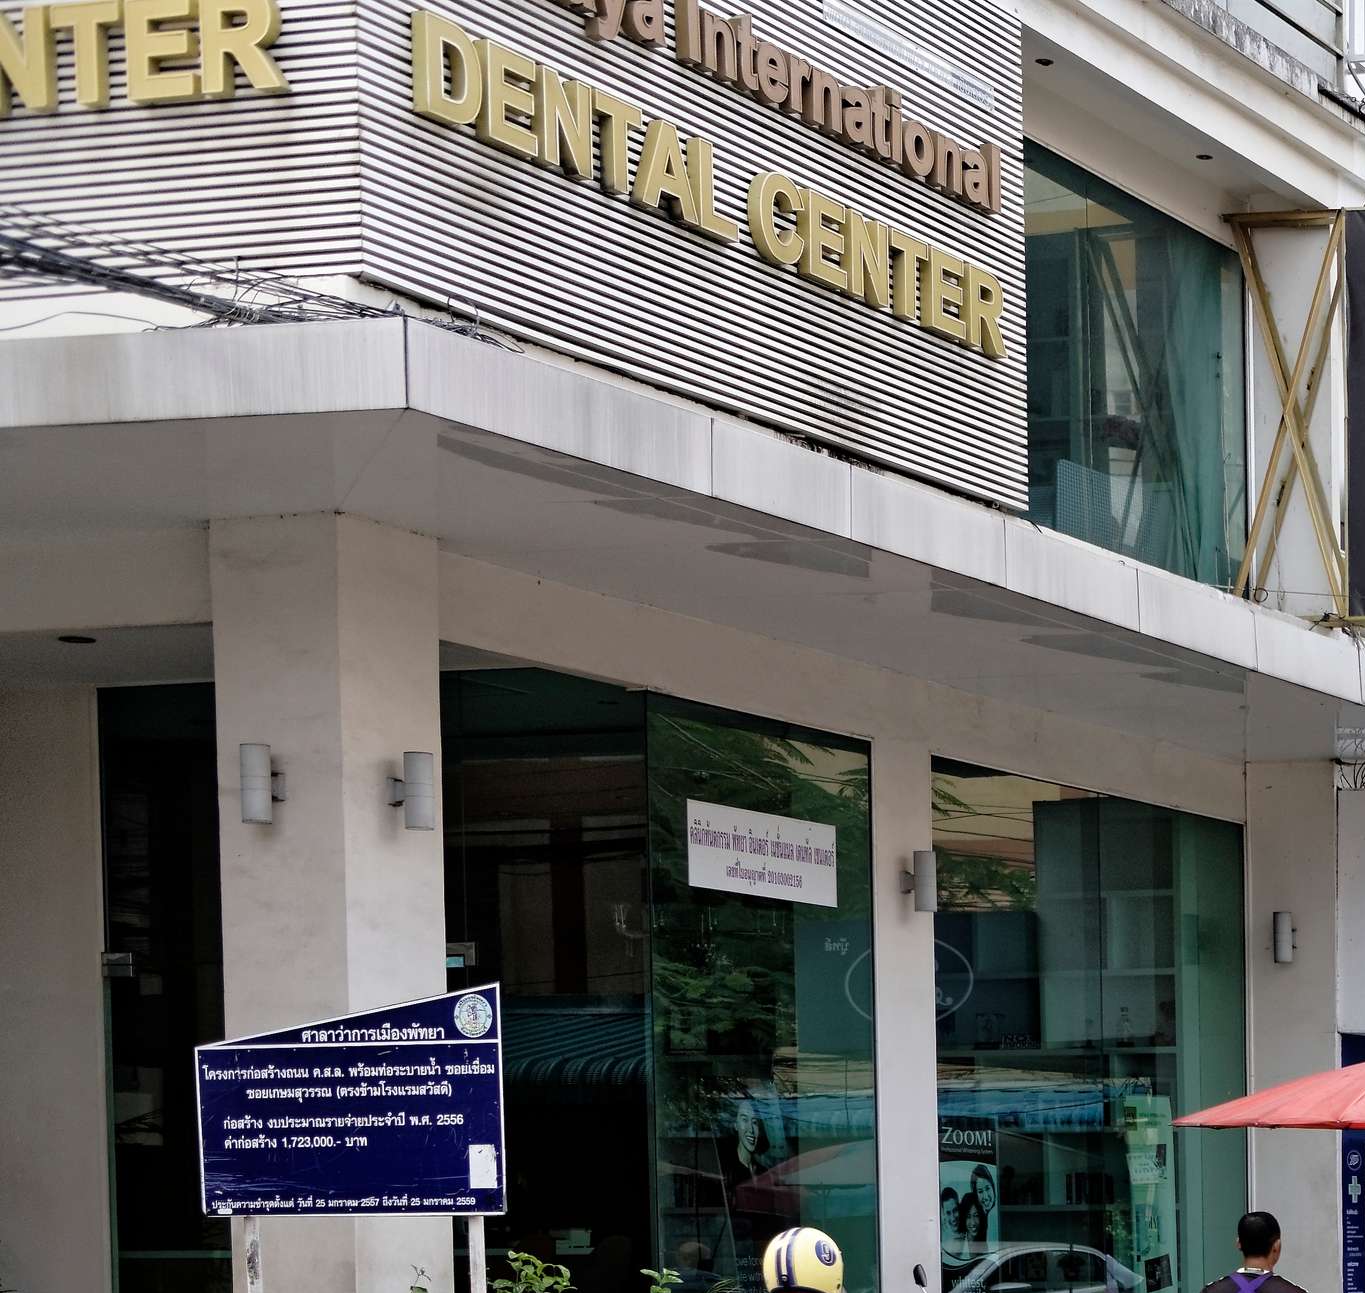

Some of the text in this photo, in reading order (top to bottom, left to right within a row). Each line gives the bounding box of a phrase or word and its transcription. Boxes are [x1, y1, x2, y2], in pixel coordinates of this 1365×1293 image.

[676, 0, 1001, 214] International
[412, 10, 740, 244] DENTAL
[748, 172, 1007, 359] CENTER
[301, 1023, 445, 1043] ศาลาว่าการเมืองพัทยา
[202, 1064, 309, 1081] โครงการก่อสร้างถนน
[348, 1058, 442, 1077] พร้อมท่อระบายน้ำ
[445, 1057, 495, 1075] ซอยเชื่อม
[223, 1112, 464, 1131] ก่อสร้าง งบประมาณรายจ่ายประจำปี พ.ศ. 2556
[224, 1134, 277, 1150] ค่าก่อสร้าง
[345, 1136, 368, 1147] บาท
[297, 1195, 313, 1208] วันที่
[315, 1199, 326, 1207] 25
[328, 1199, 358, 1208] มกราคม
[410, 1198, 421, 1206] 25
[423, 1197, 454, 1206] มกราคม
[456, 1196, 476, 1206] 2559
